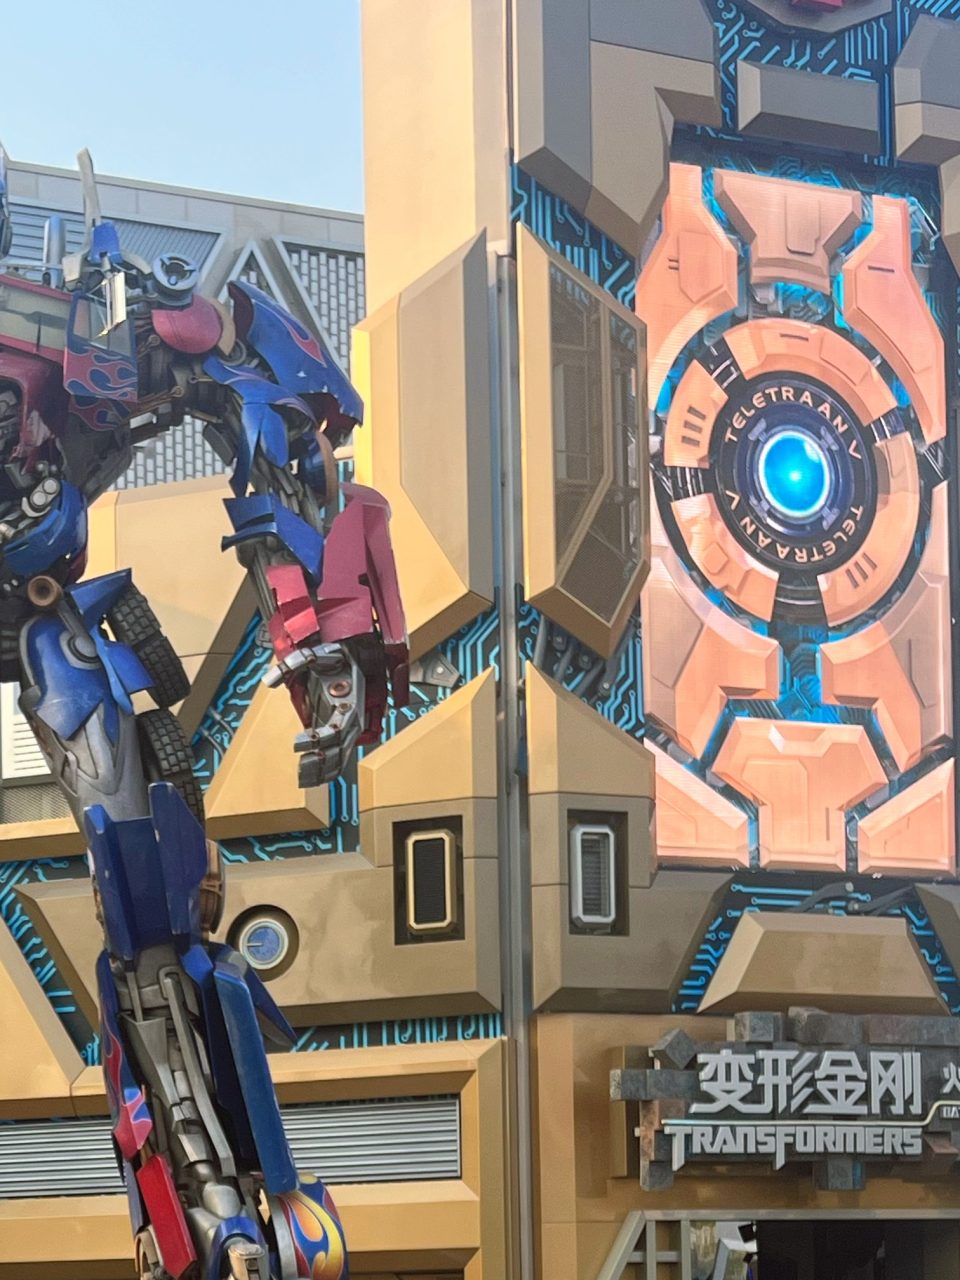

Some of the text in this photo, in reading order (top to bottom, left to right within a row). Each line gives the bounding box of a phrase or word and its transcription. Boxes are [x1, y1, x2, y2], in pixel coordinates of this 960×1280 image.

[725, 386, 849, 443] TELETRAAN
[740, 504, 863, 563] TELETRAAN
[689, 1049, 923, 1116] 变形金刚
[663, 1126, 922, 1172] TRANSFORMERS
